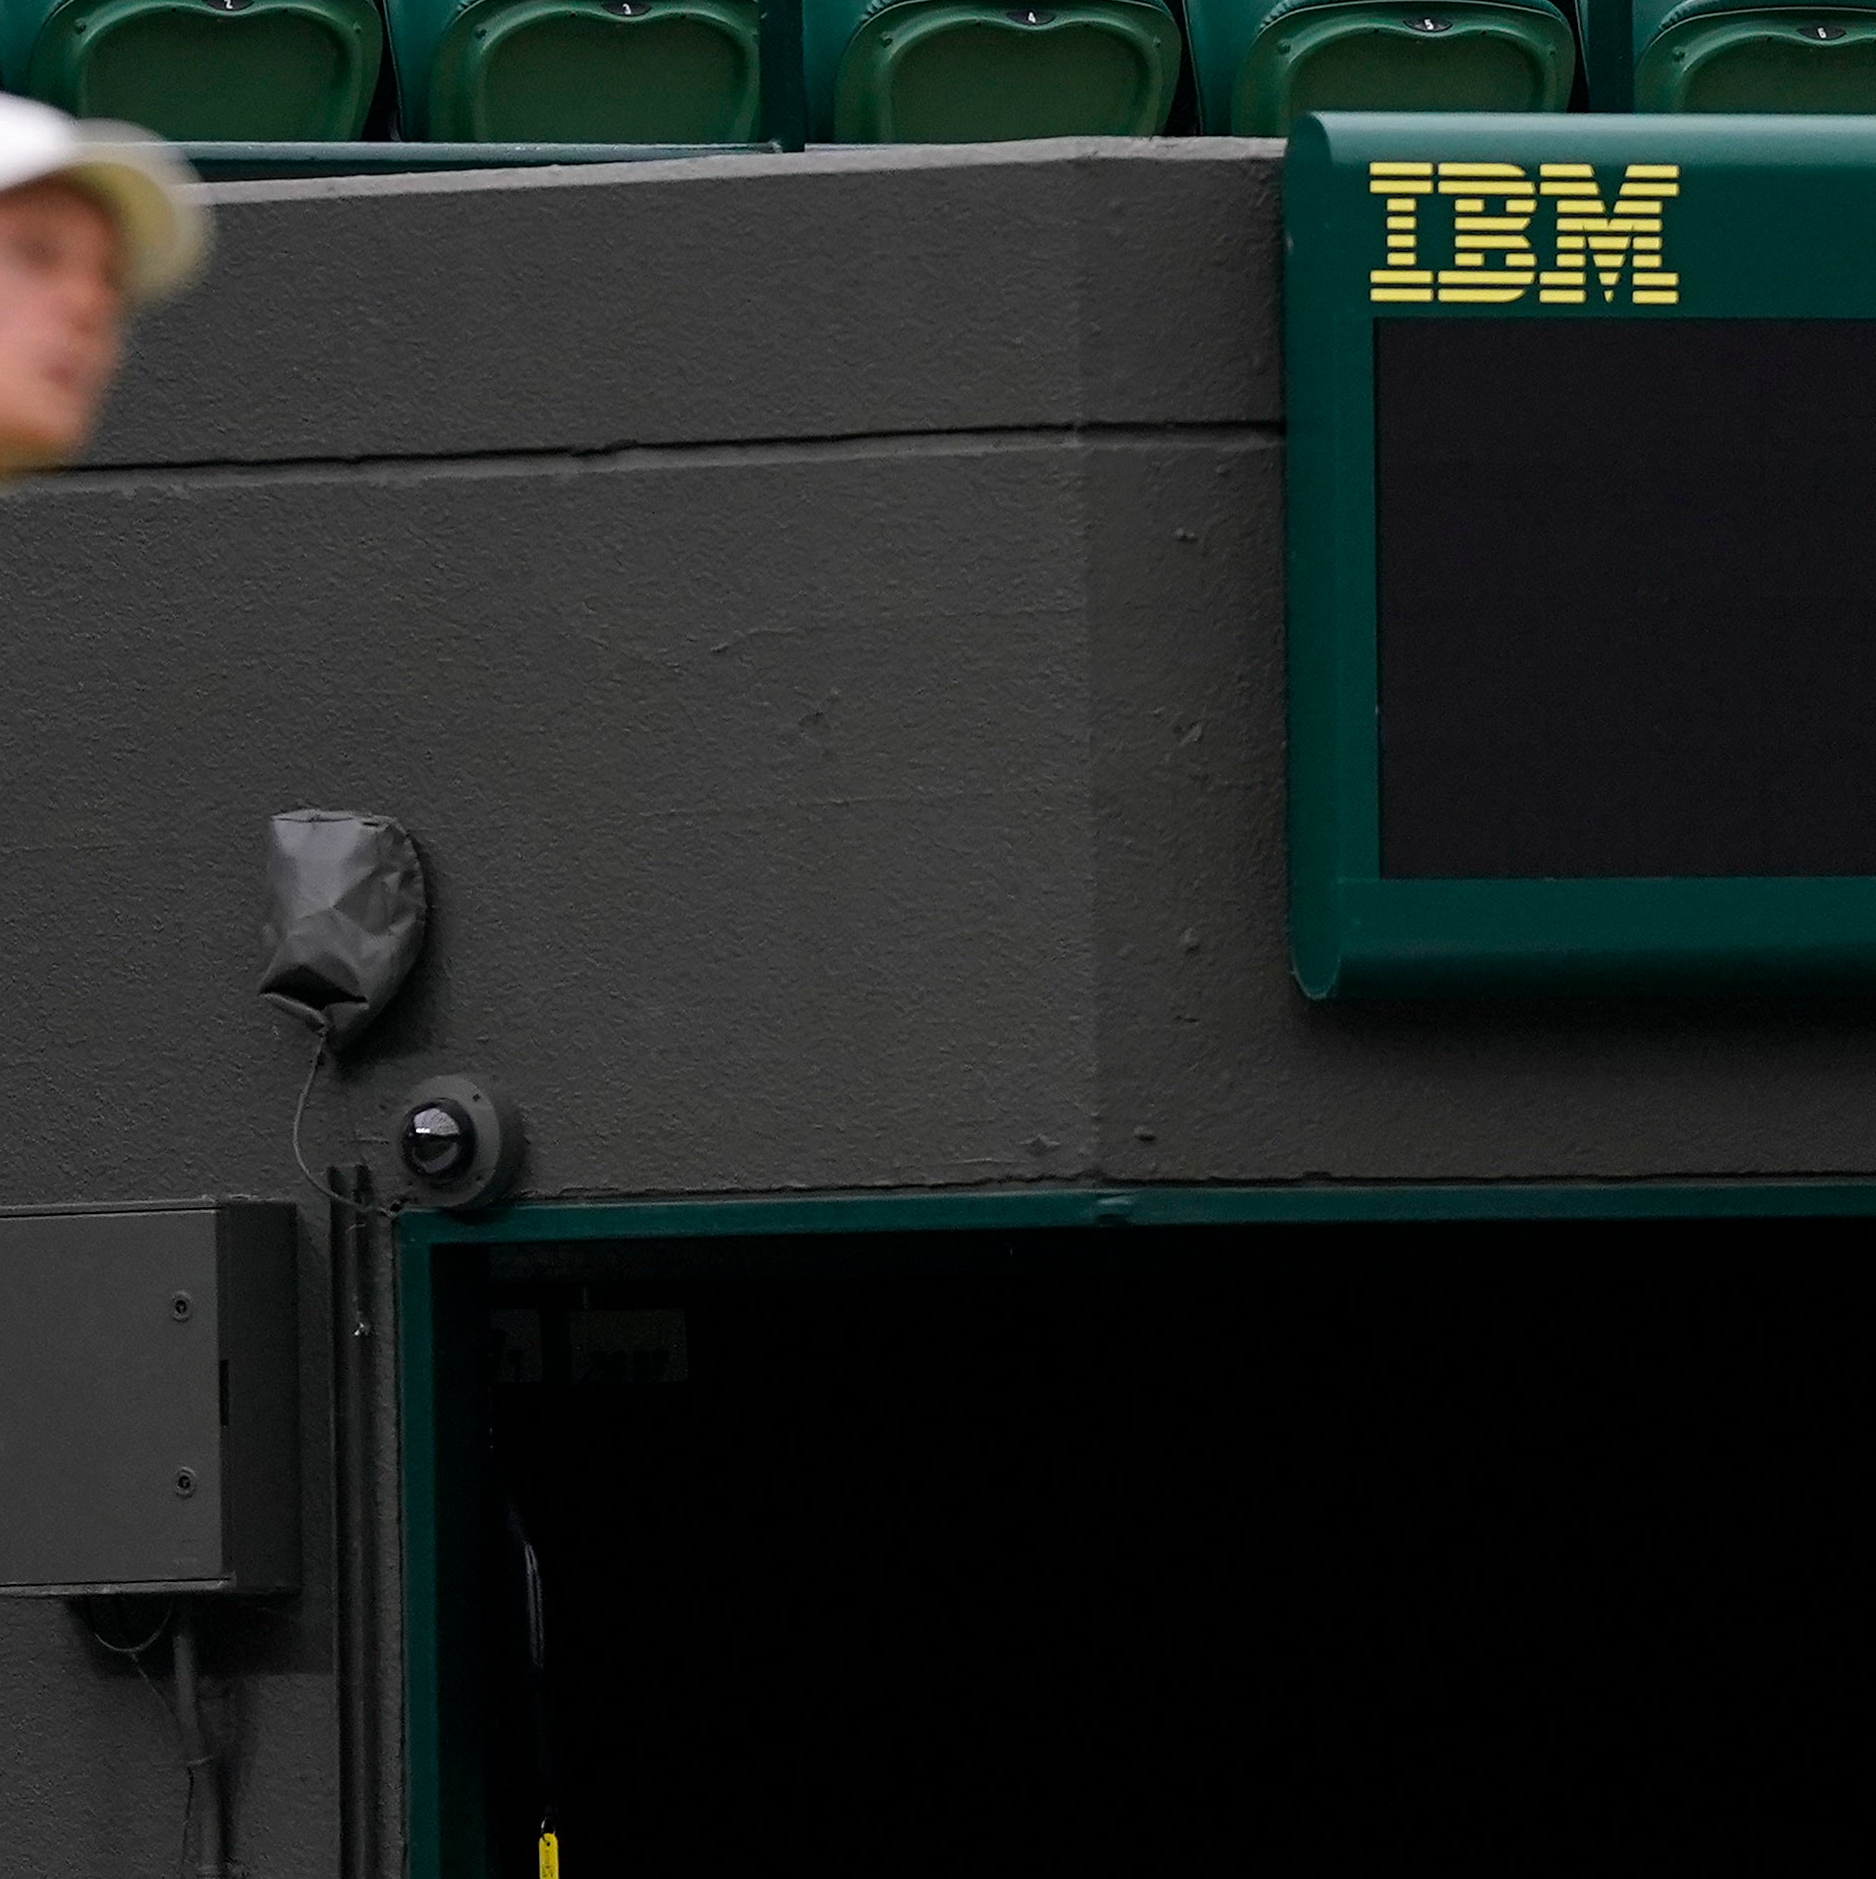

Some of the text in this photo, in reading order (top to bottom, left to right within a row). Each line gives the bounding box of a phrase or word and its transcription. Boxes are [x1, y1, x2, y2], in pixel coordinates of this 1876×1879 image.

[623, 3, 632, 15] 3
[1027, 12, 1037, 23] 4
[1424, 18, 1434, 30] 5
[1817, 27, 1827, 38] 6
[1370, 162, 1680, 304] IBM
